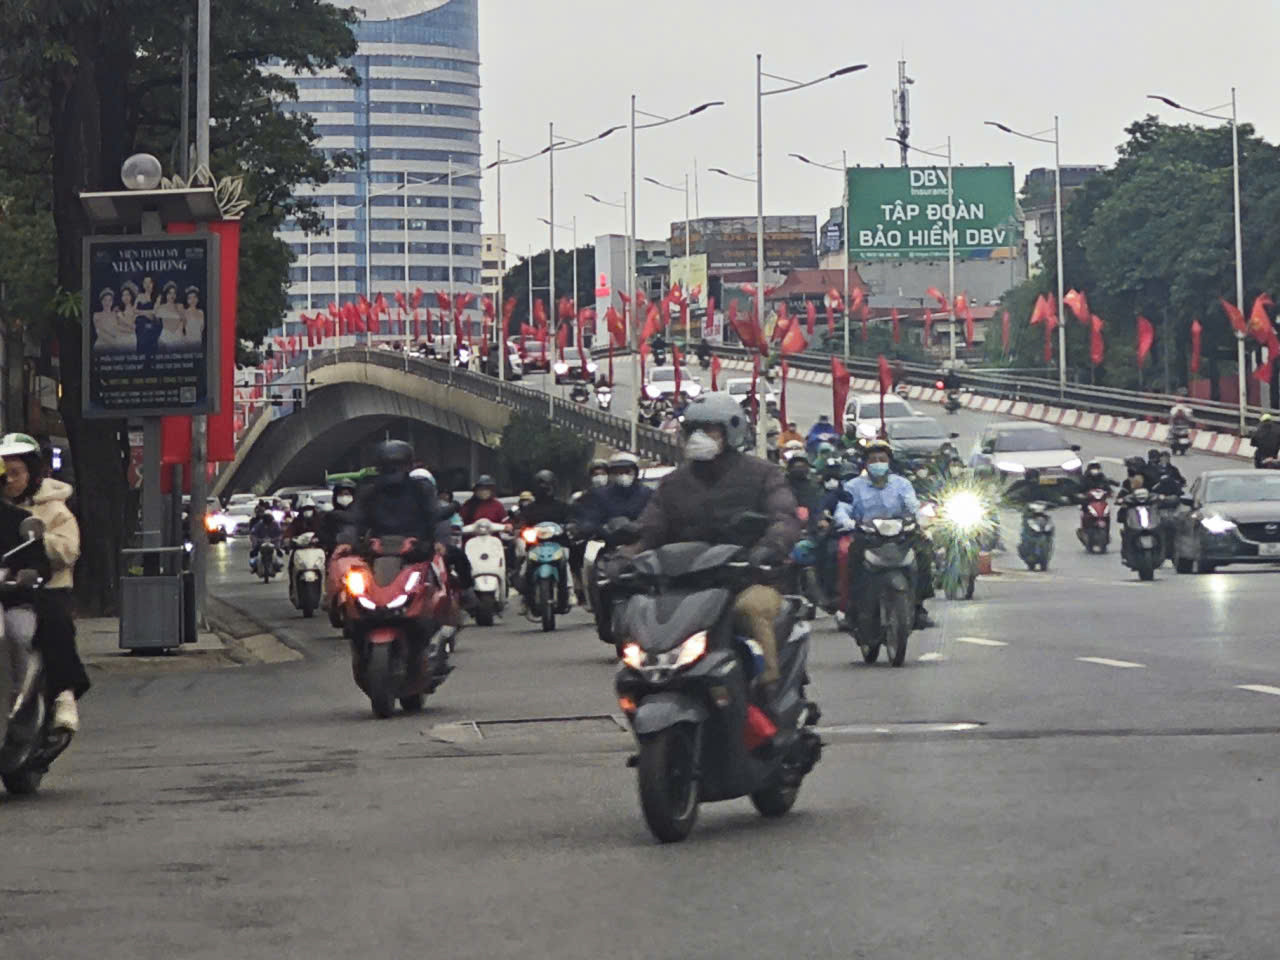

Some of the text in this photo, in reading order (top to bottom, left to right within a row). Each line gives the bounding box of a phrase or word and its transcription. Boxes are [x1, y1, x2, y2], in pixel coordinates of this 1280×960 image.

[881, 199, 984, 225] TẬP ĐOÀN
[859, 224, 901, 246] BẢO
[908, 221, 959, 246] HIỂM
[966, 228, 1006, 246] DBV
